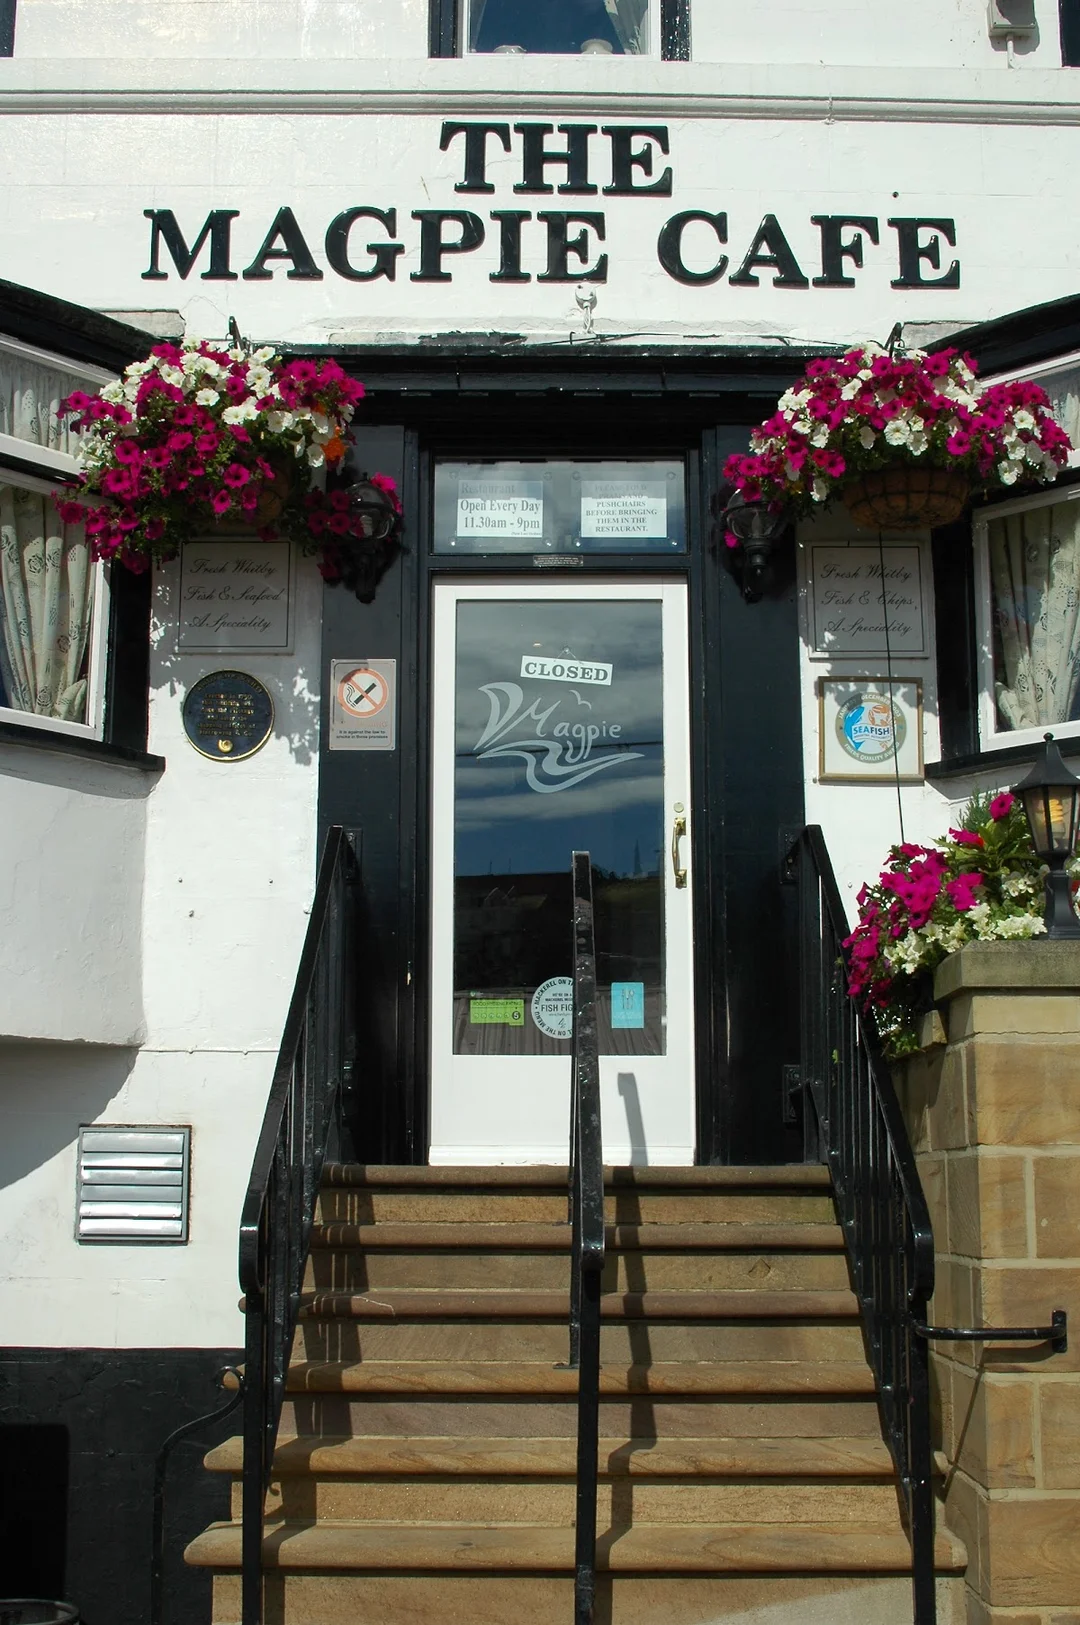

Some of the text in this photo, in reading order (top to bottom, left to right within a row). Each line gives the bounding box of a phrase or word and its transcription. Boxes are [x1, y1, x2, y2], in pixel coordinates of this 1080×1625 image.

[441, 120, 673, 197] THE
[141, 204, 961, 291] MAGPIE CAFE
[461, 482, 516, 494] Restaurant
[461, 499, 541, 514] Open Every Day
[585, 508, 658, 517] BEFORE BRINGING
[596, 500, 647, 508] PUSHCHAIRS
[464, 516, 507, 529] 11.30am
[516, 516, 541, 531] 9pm
[595, 525, 649, 533] RESTAURANT.
[630, 516, 648, 524] THE
[190, 558, 278, 578] Fresh Whitby
[820, 563, 912, 583] Fresh Whitby
[184, 586, 286, 606] Fish & Seafood
[820, 590, 914, 611] Fish & Chips
[188, 612, 273, 632] A Speciality
[823, 617, 913, 637] A Speciality
[524, 661, 609, 682] CLOSED
[483, 697, 622, 764] Magpie
[853, 725, 890, 736] SEAFISH
[534, 980, 557, 1006] MACKEREL
[541, 1003, 574, 1013] FISH FIG
